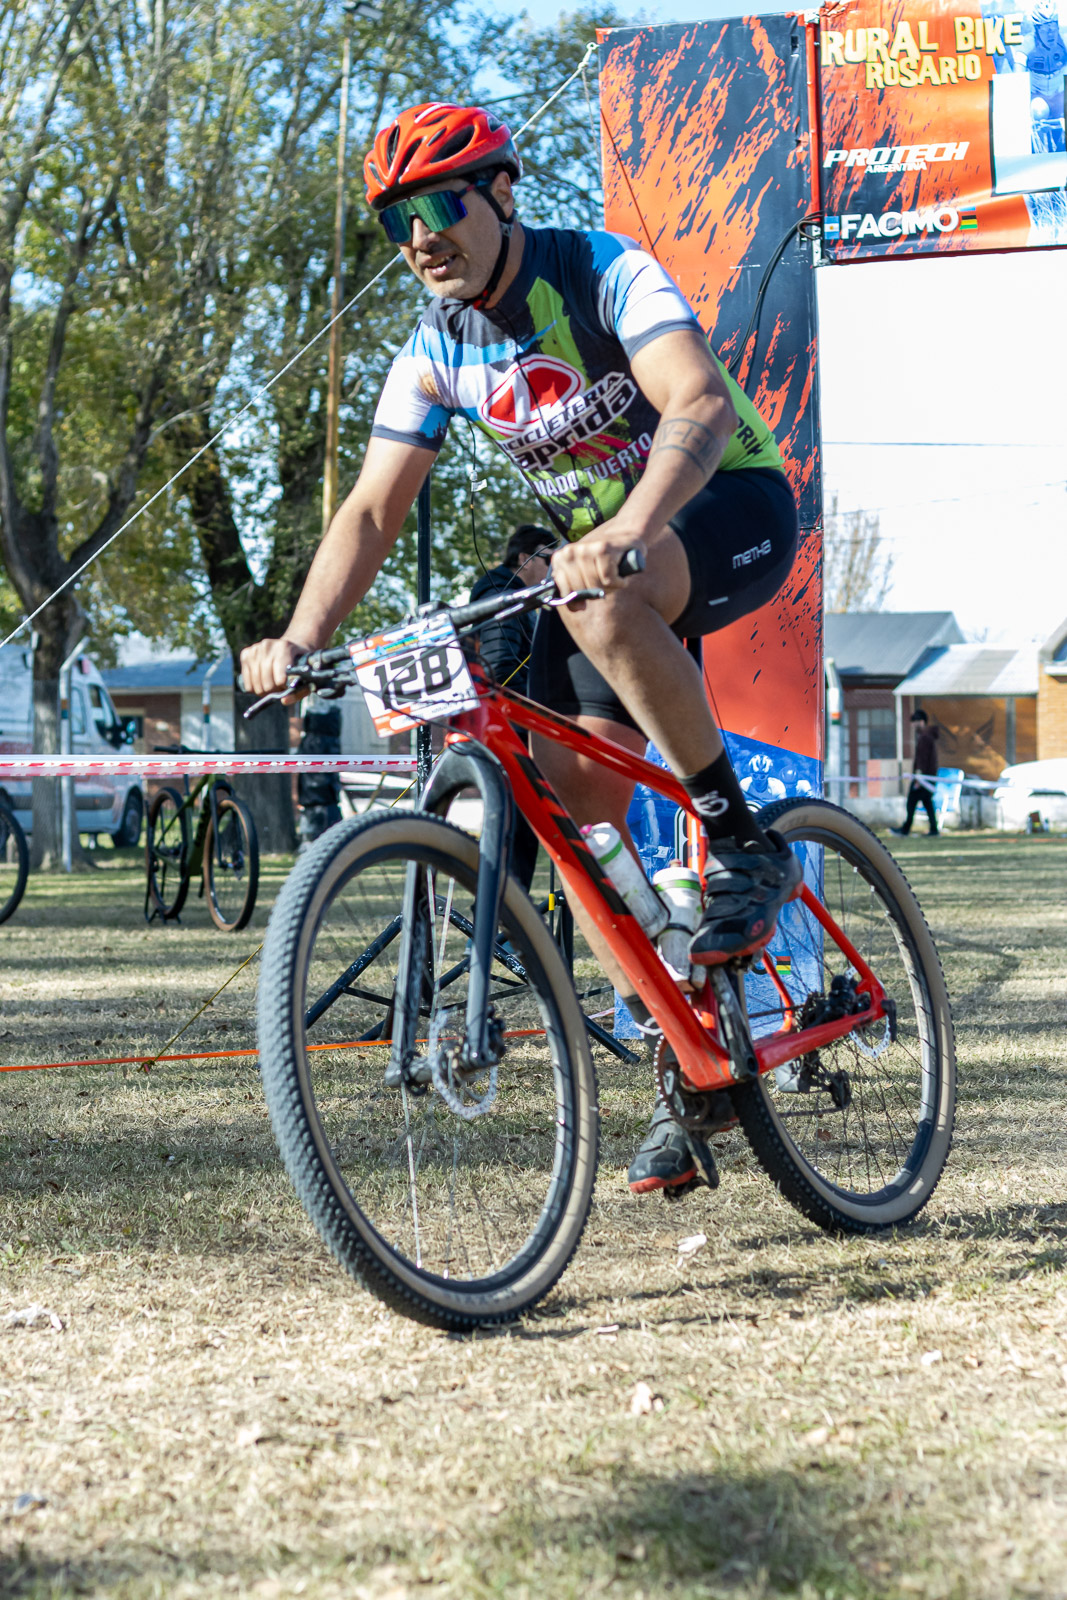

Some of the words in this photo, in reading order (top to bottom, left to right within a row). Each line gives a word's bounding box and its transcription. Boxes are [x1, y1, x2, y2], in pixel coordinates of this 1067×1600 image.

[820, 21, 939, 66] RURAL
[954, 13, 1024, 56] BIKE
[865, 53, 982, 89] ROSARIO
[823, 141, 970, 168] PROTECH
[840, 207, 960, 240] FACIMO
[502, 371, 625, 451] ICICLETERIA
[583, 432, 652, 485] TUERTO
[374, 649, 452, 711] 128
